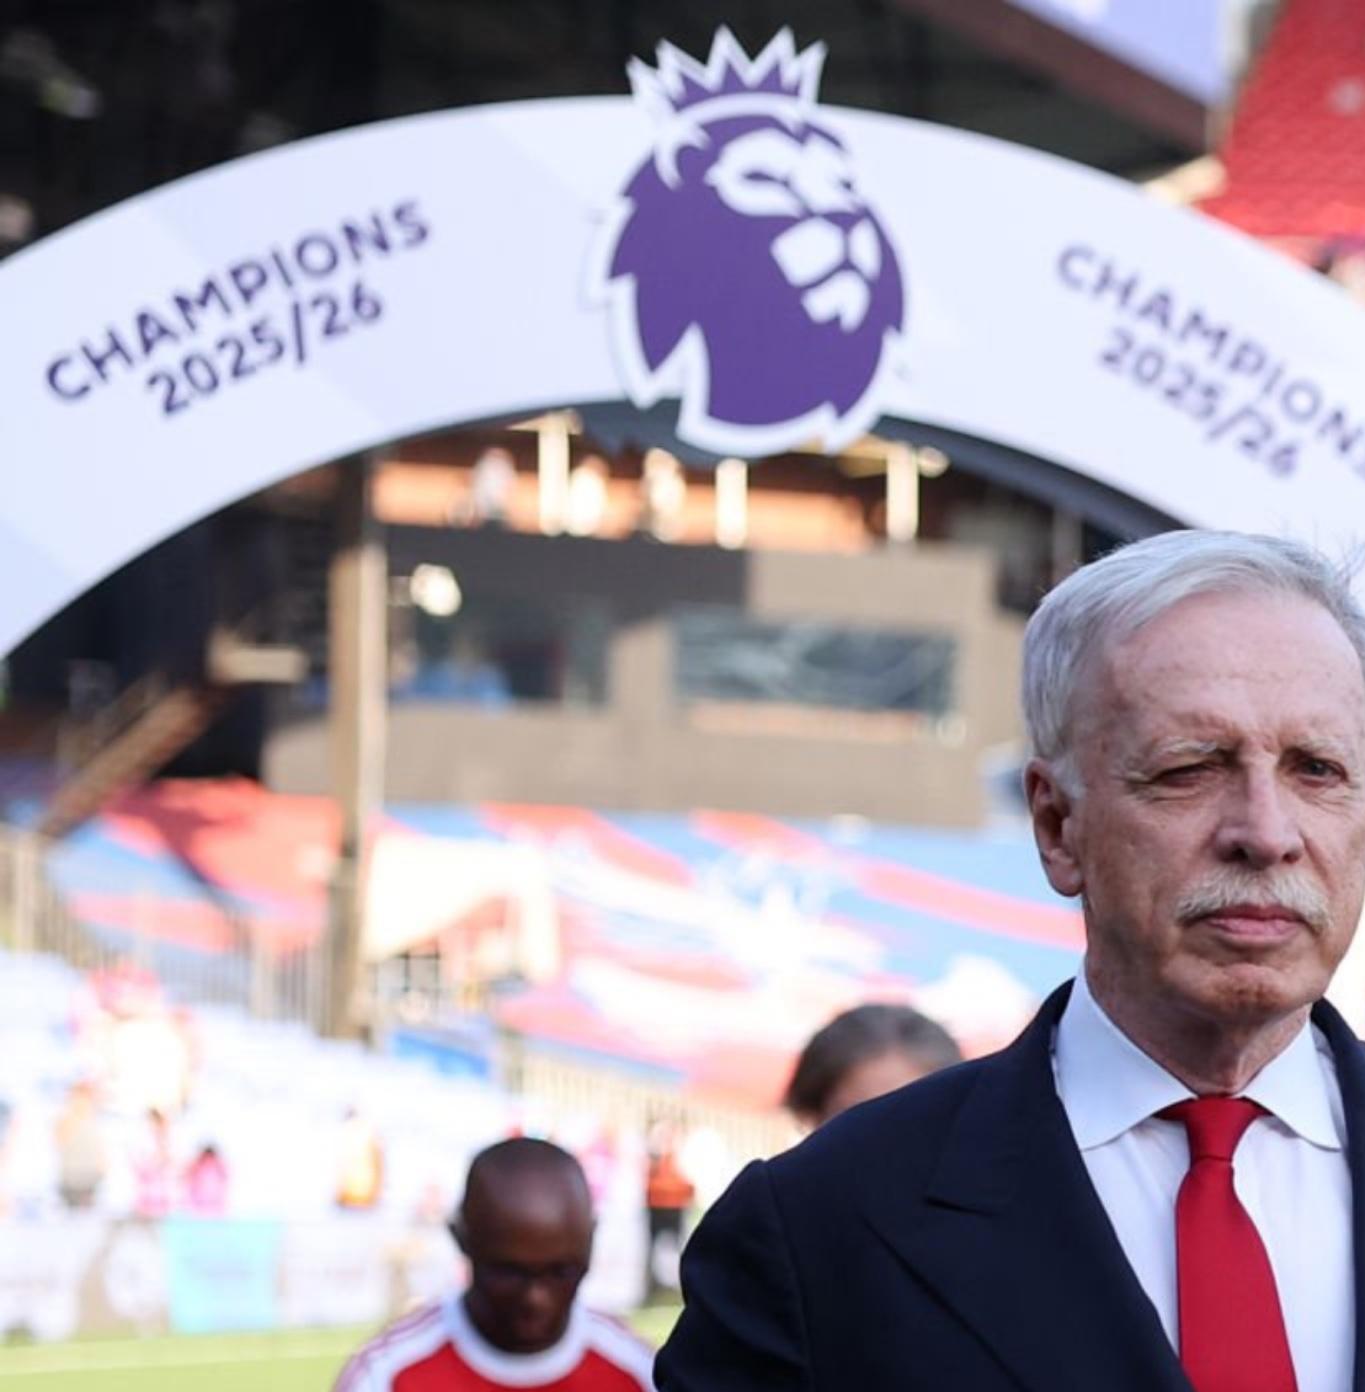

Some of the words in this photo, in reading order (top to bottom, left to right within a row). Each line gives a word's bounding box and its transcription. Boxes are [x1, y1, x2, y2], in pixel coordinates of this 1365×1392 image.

[46, 201, 430, 402] CHAMPIONS
[147, 280, 383, 416] 2025/26
[1099, 326, 1301, 479] 2025/26
